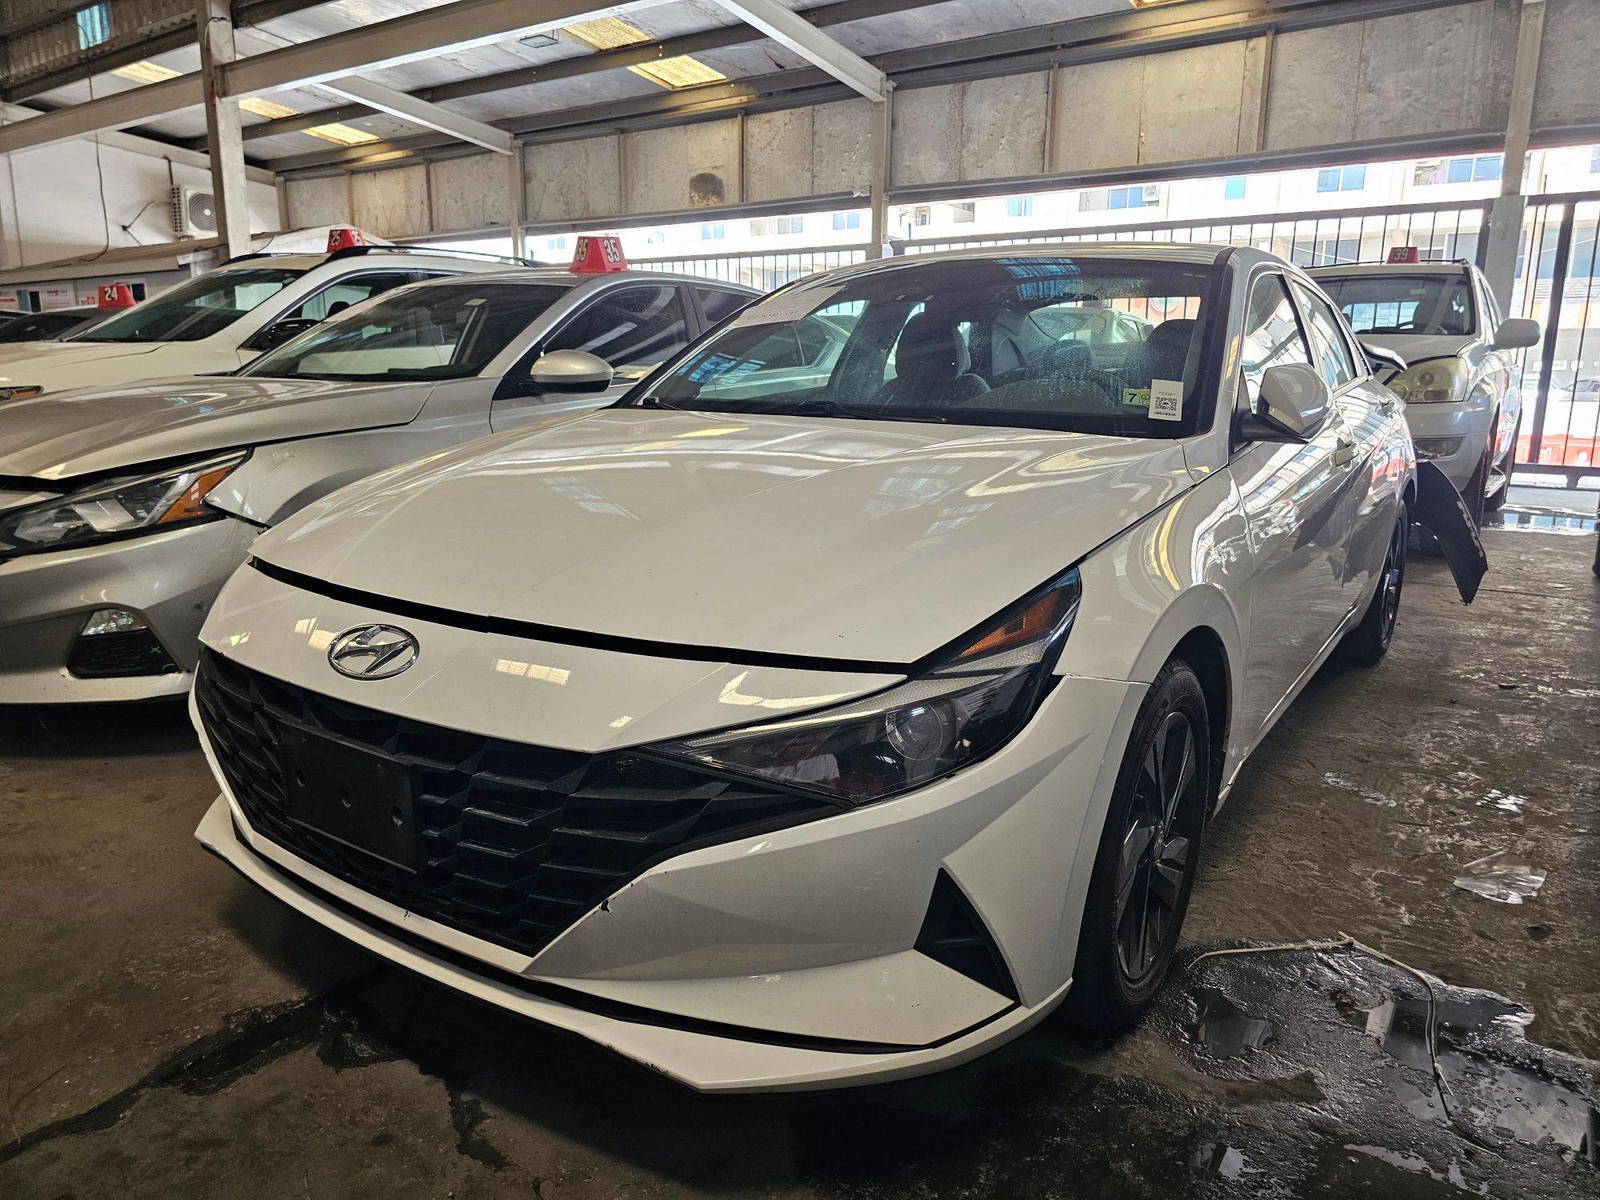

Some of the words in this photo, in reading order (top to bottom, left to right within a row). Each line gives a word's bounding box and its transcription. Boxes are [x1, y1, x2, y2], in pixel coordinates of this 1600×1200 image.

[604, 239, 620, 262] 35
[104, 286, 119, 301] 24
[1128, 393, 1138, 403] 7
